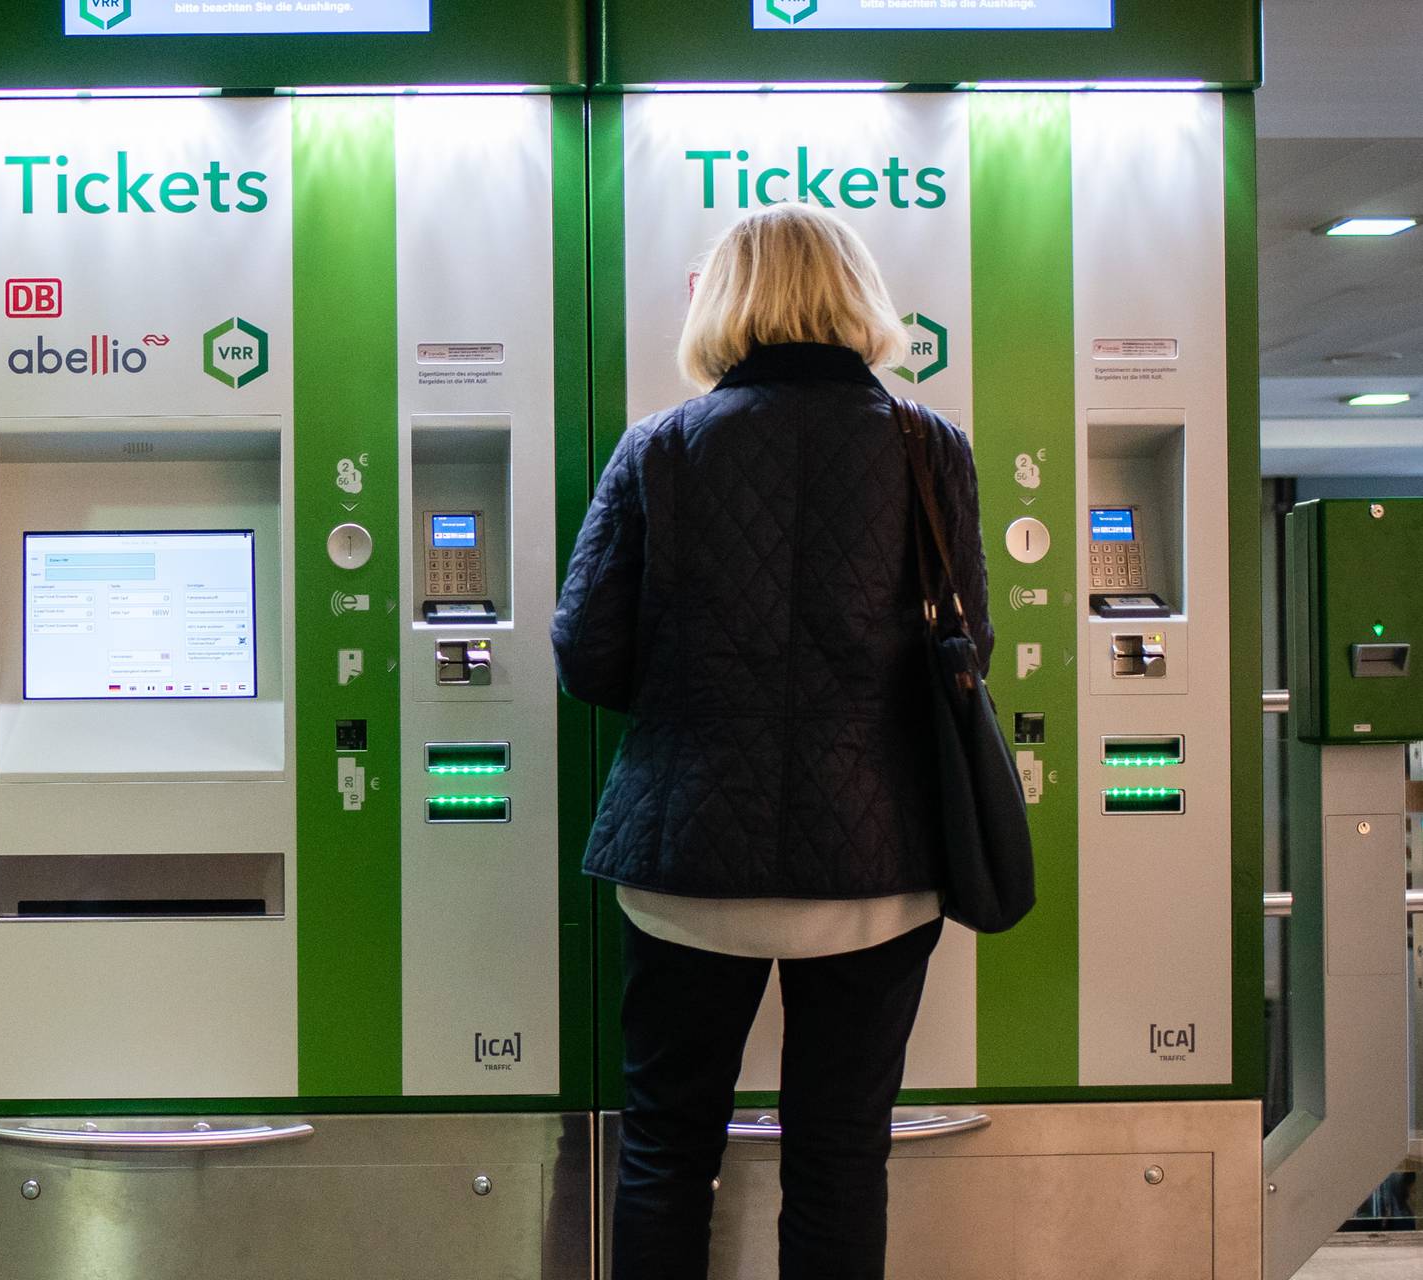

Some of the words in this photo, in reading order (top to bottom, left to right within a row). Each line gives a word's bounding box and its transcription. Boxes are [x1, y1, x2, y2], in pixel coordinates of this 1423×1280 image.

[175, 3, 200, 13] bitte
[202, 3, 252, 13] beachten
[255, 2, 272, 12] Sie
[275, 2, 292, 12] die
[4, 151, 268, 214] Tickets
[685, 146, 947, 209] Tickets
[12, 285, 55, 312] DB
[218, 346, 254, 360] VRR
[910, 342, 933, 355] RR
[8, 335, 147, 376] abellio
[359, 453, 368, 466] €
[1036, 448, 1046, 462] €
[342, 462, 349, 472] 2
[1020, 458, 1027, 468] 2
[344, 776, 354, 788] 20
[1023, 770, 1032, 782] 20
[1048, 770, 1058, 784] €
[370, 776, 380, 790] €
[1028, 787, 1036, 798] 10
[350, 794, 359, 805] 10
